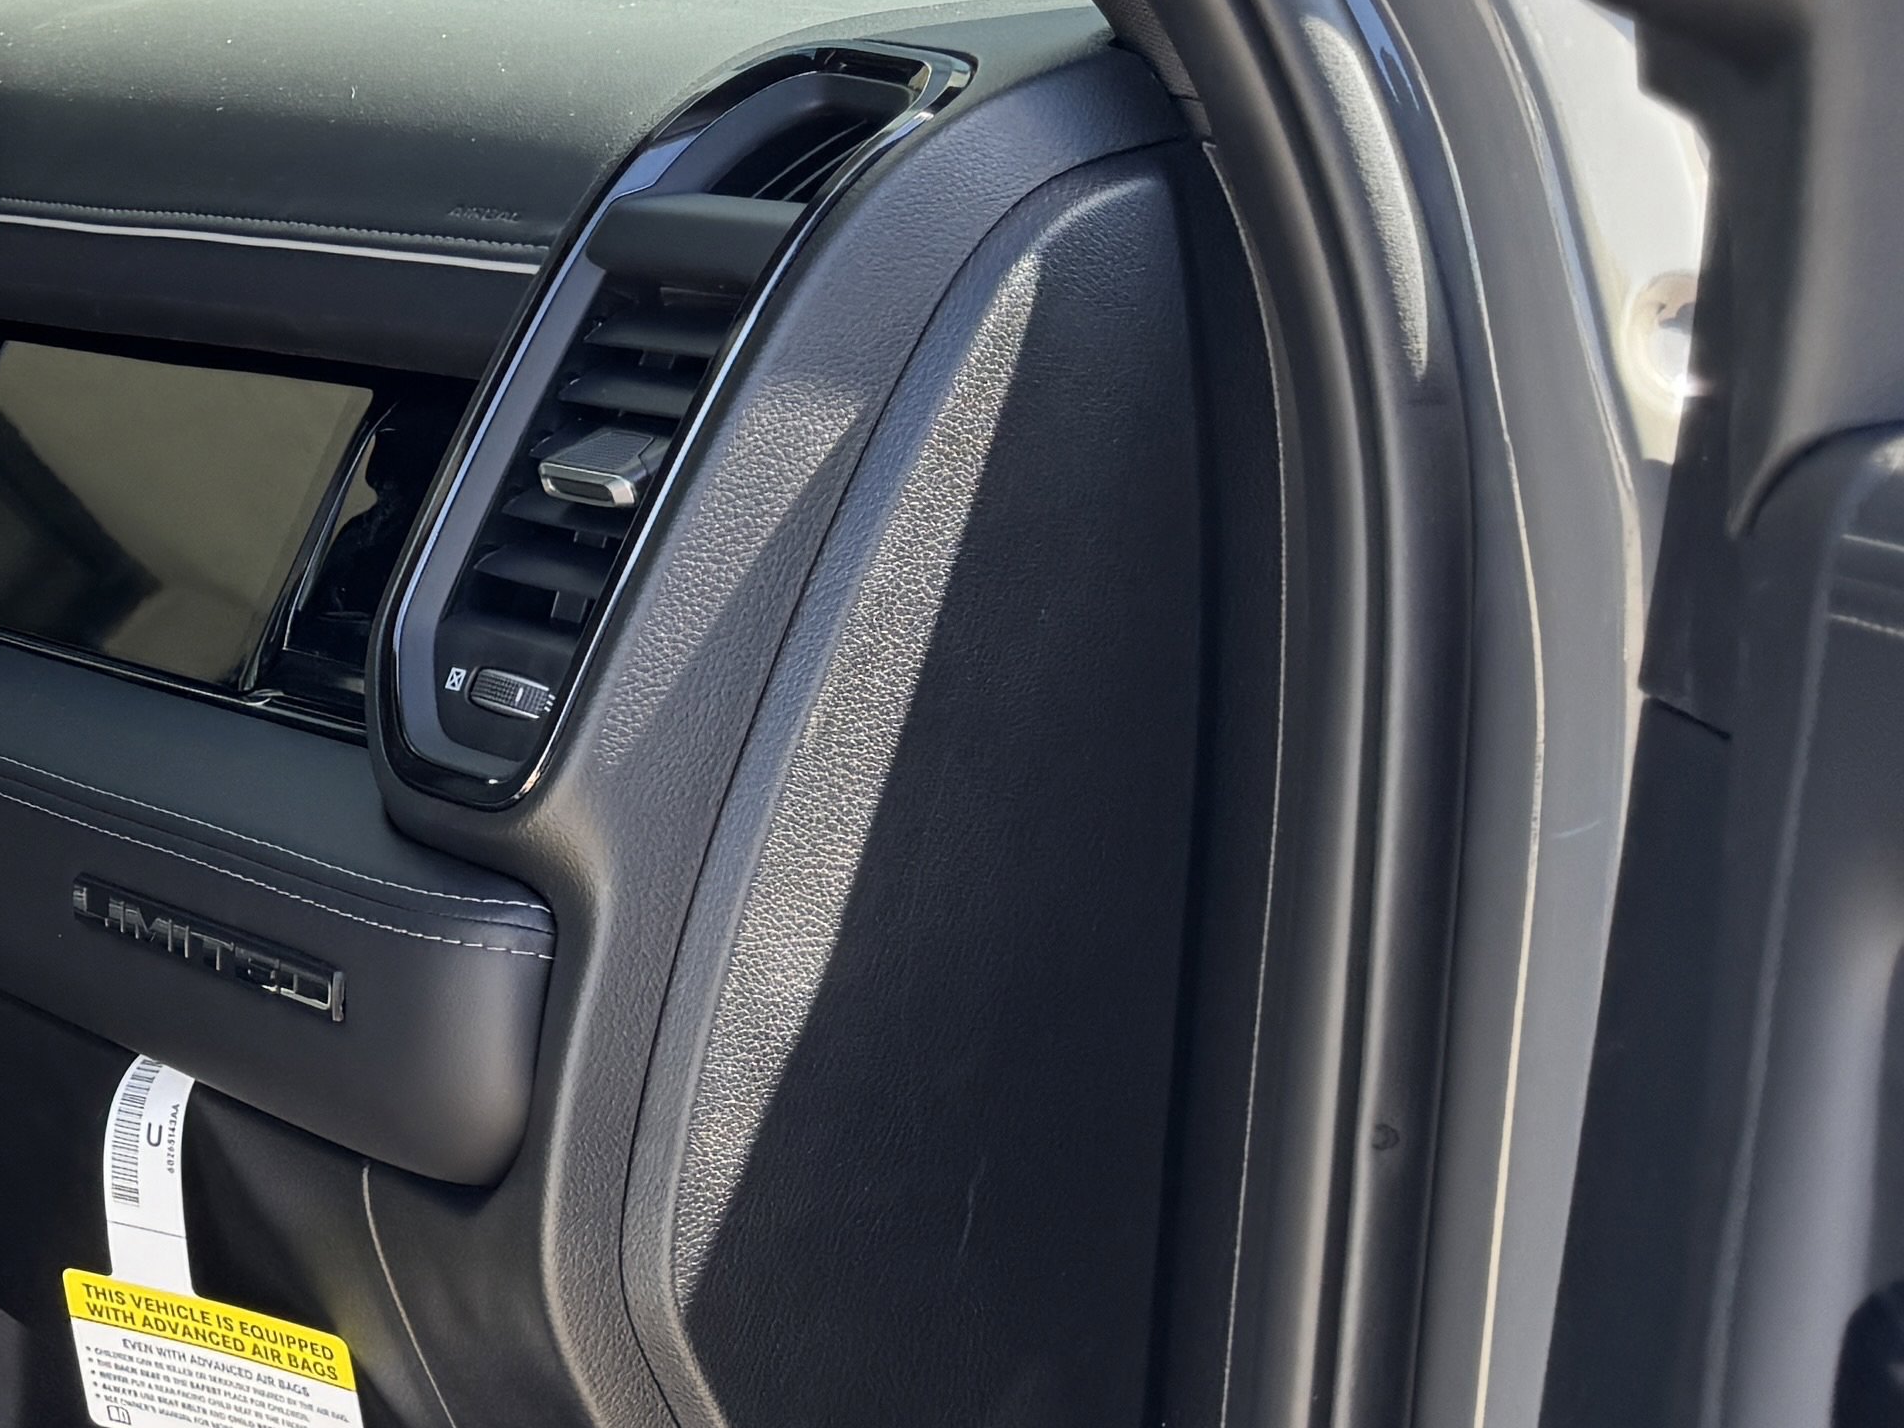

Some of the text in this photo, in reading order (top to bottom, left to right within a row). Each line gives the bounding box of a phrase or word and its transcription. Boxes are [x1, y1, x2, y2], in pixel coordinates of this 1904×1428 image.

[82, 1283, 335, 1361] THIS VEHICLE IS EQUIPPED
[85, 1302, 339, 1380] WITH ADVANCED AIR BAGS
[121, 1338, 310, 1396] EVEN WITH ADVANCED AIR BAGS
